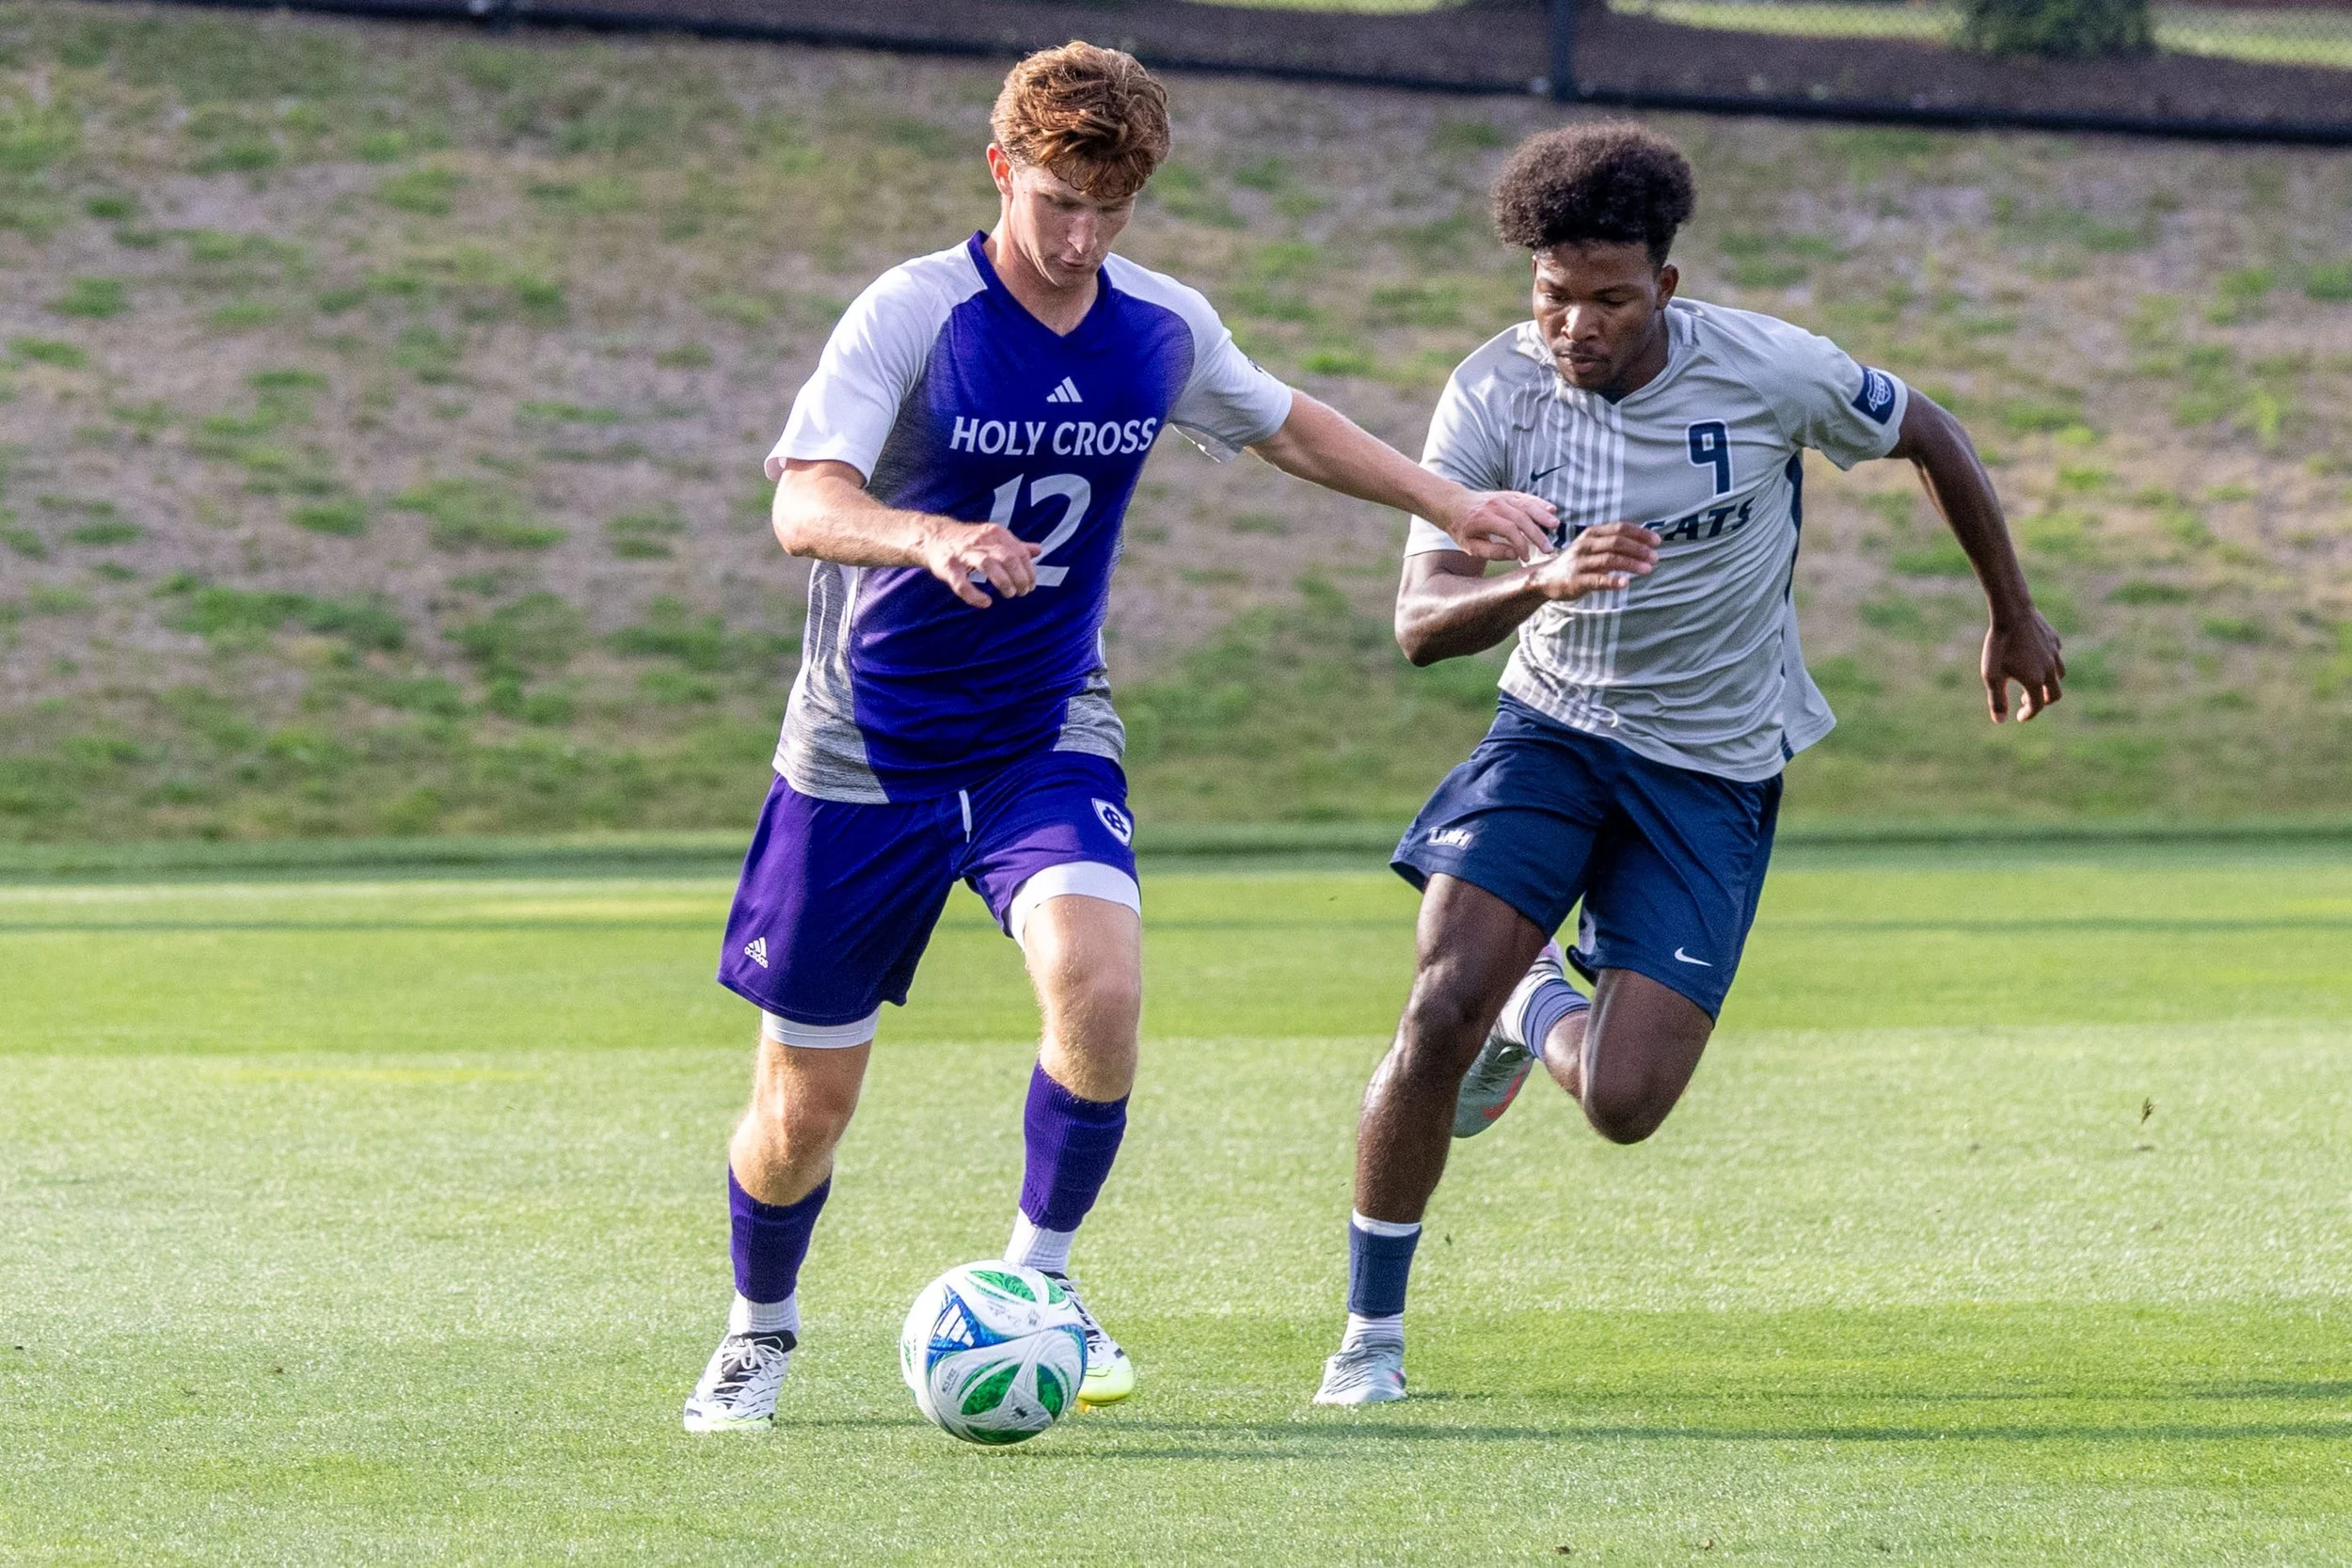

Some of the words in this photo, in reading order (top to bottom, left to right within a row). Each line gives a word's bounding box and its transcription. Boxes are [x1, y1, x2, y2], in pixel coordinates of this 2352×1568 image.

[949, 416, 1046, 456] HOLY
[1052, 417, 1157, 456] CROSS
[1685, 418, 1734, 499] 9
[967, 472, 1091, 587] 12
